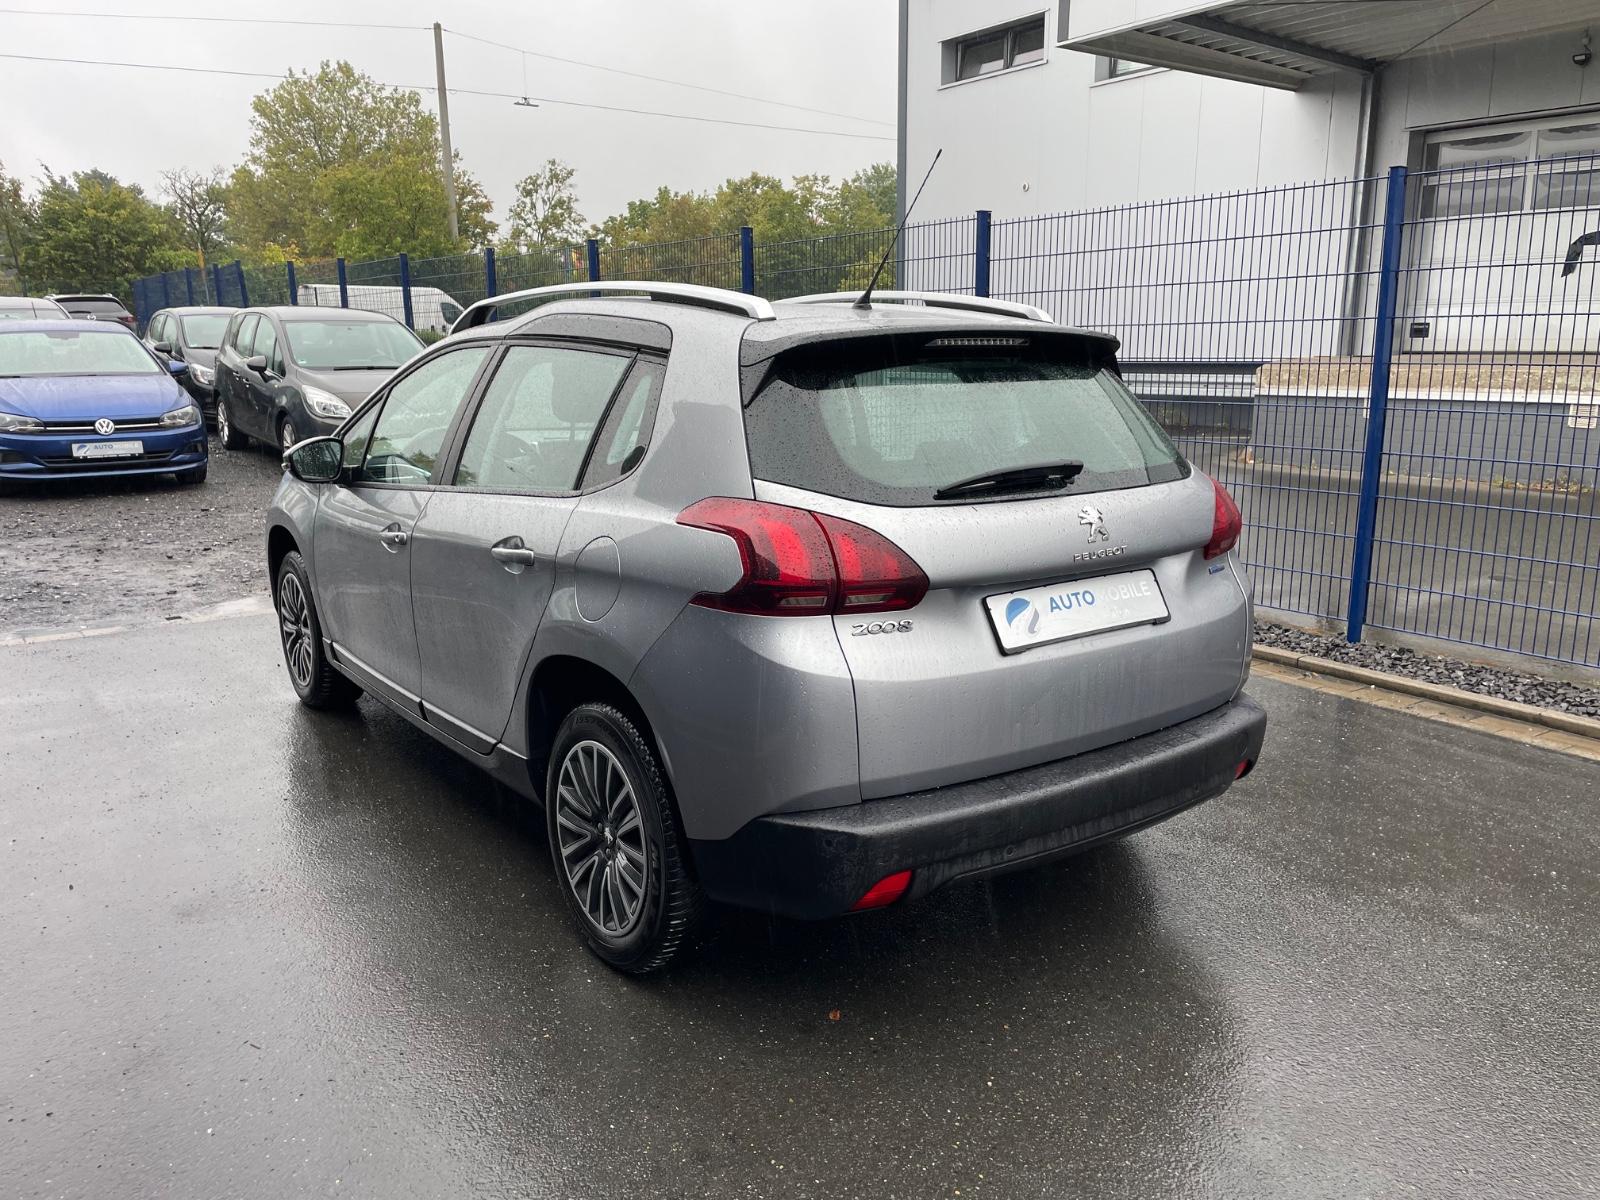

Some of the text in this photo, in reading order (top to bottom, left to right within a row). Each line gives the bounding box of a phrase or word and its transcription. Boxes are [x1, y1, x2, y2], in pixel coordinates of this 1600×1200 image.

[1073, 545, 1128, 562] PEUGEOT
[1049, 590, 1096, 612] AUTO
[1098, 581, 1152, 602] OBILE
[851, 619, 914, 636] 2008
